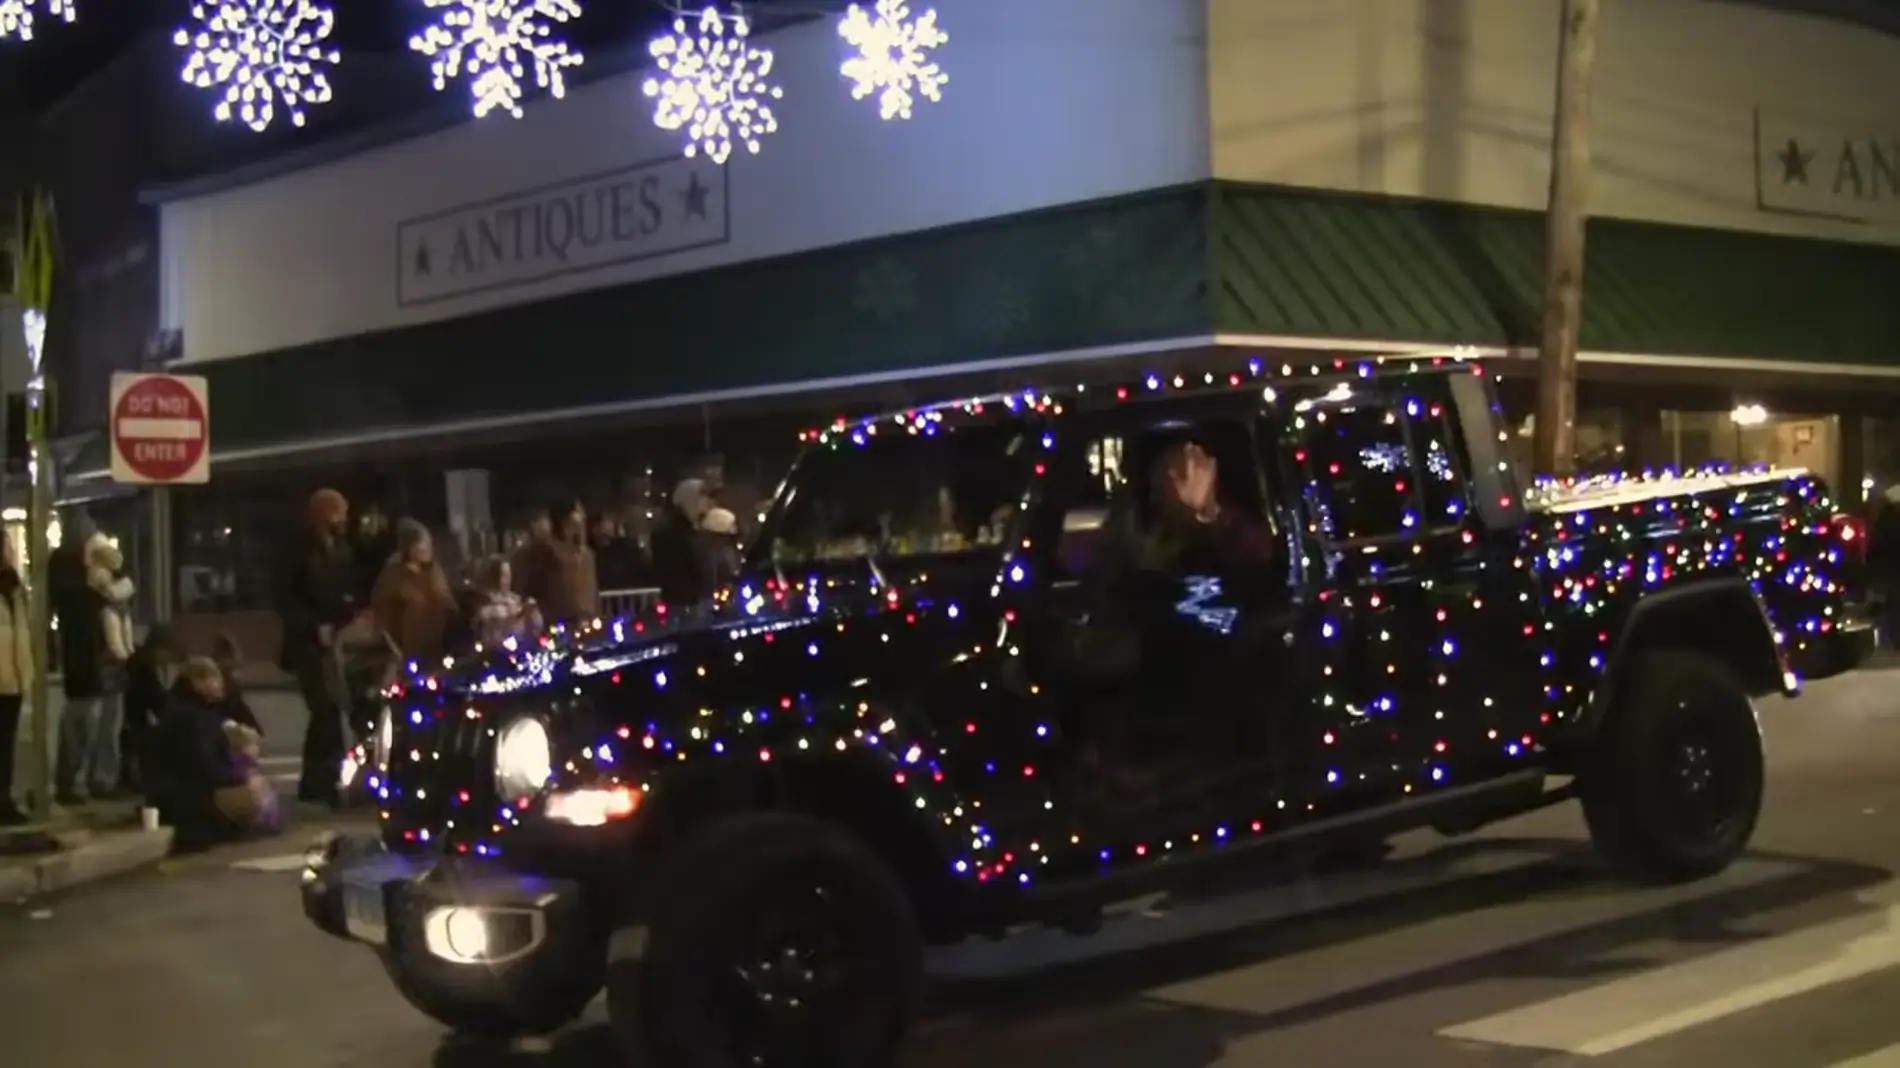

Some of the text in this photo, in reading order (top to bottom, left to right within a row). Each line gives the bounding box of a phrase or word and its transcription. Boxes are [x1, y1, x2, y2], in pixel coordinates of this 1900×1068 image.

[449, 174, 662, 273] ANTIQUES
[128, 395, 189, 415] DO NOT
[134, 442, 187, 461] ENTER
